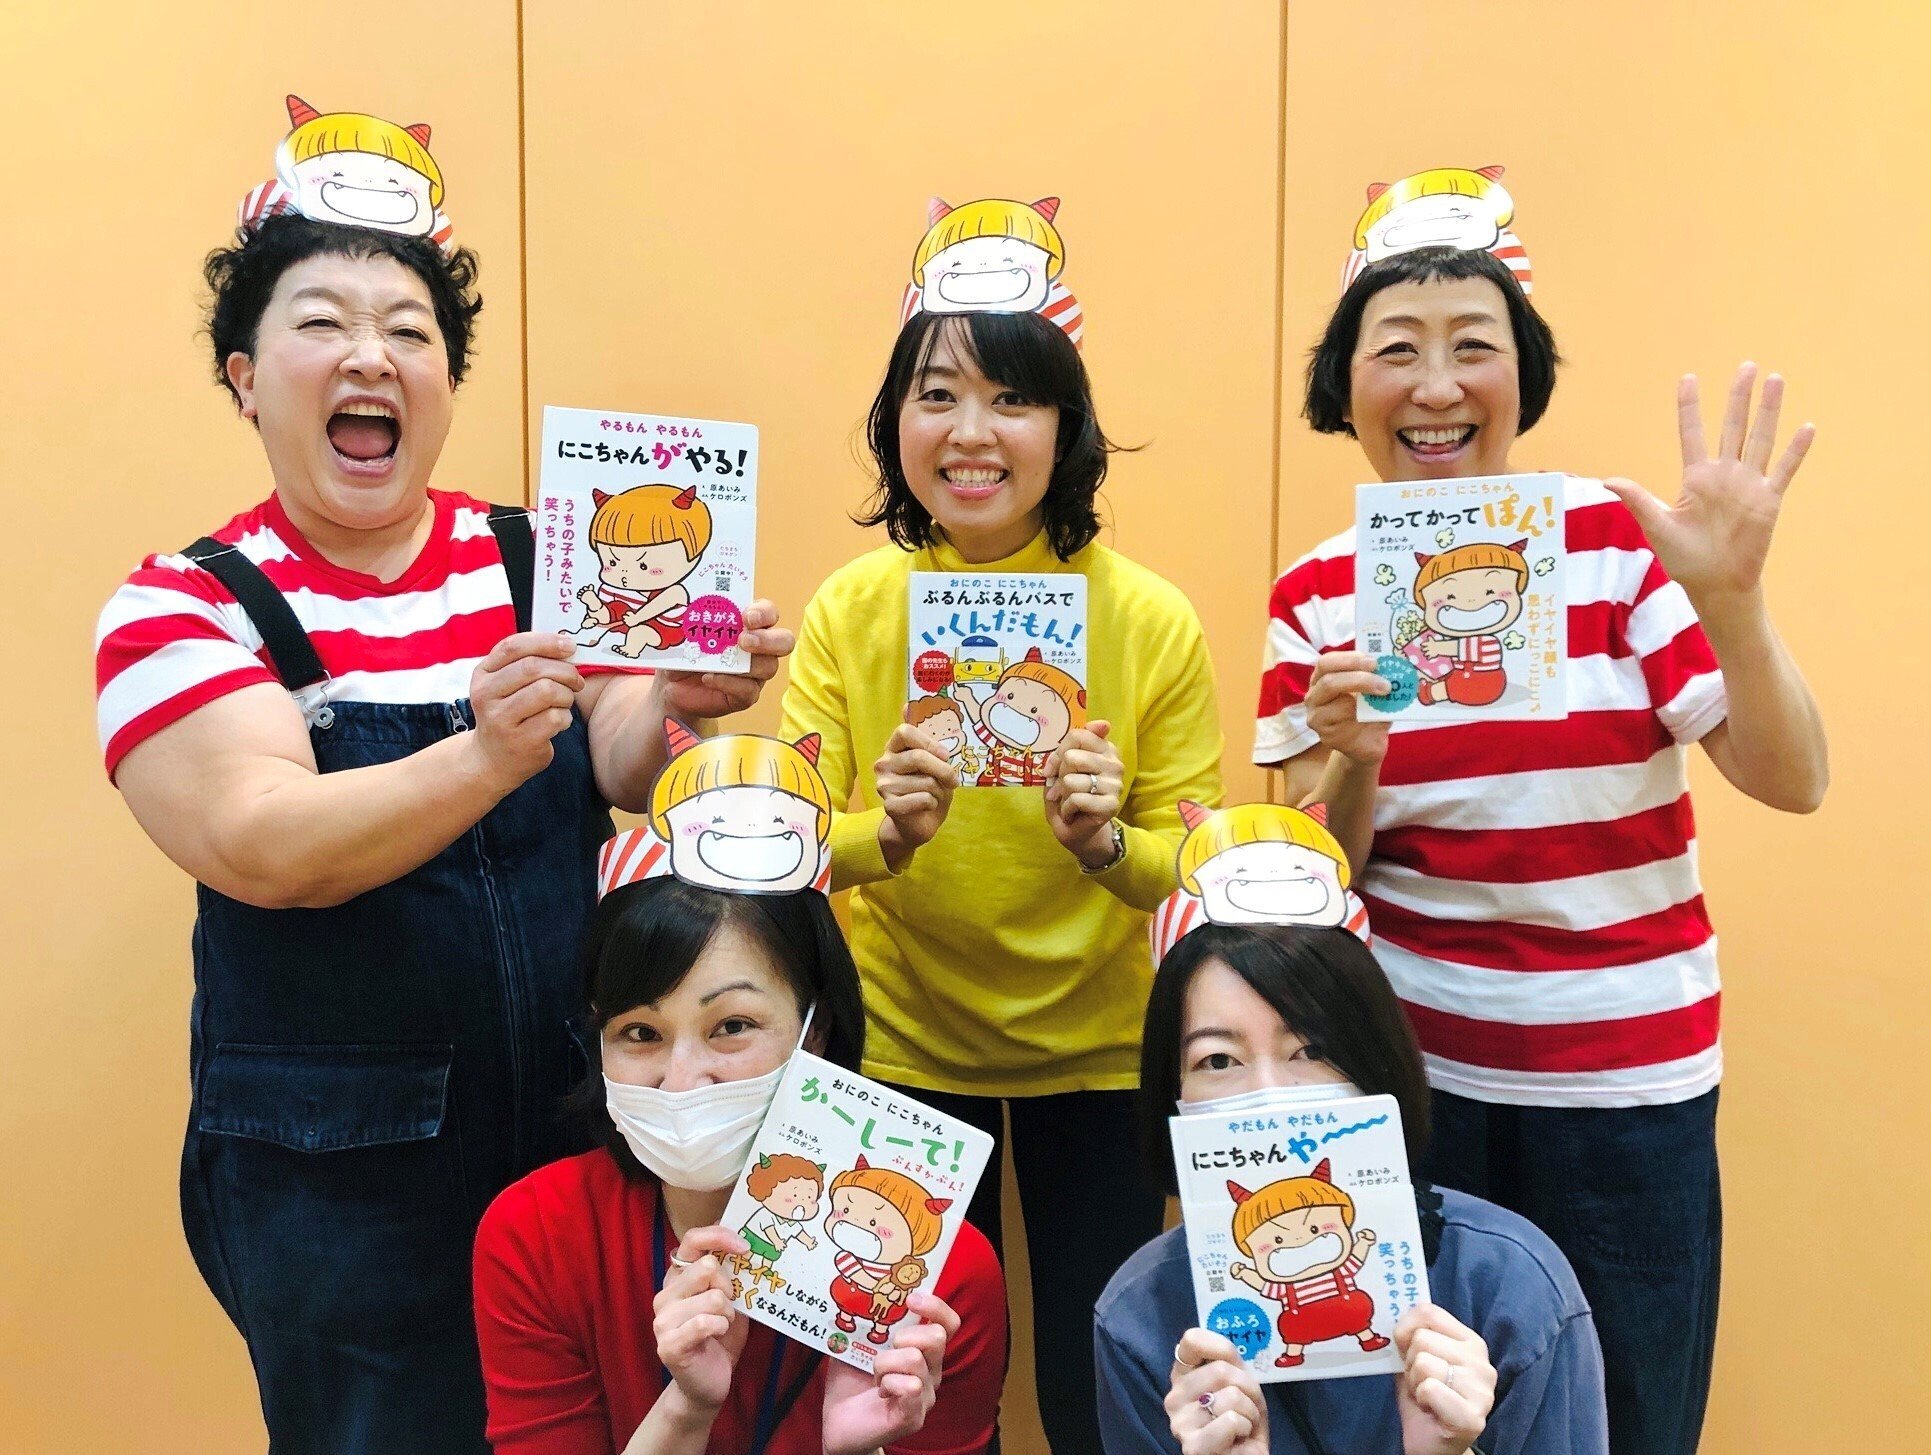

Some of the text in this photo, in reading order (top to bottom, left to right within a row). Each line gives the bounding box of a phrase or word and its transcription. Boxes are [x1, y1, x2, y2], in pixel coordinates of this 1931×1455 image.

[600, 419, 703, 439] やるもん やるもん
[558, 440, 748, 477] にこちゃんがやる!
[709, 483, 742, 494] 原あいみ
[1401, 483, 1514, 499] おにのこ にこちゃん
[544, 497, 559, 582] 笑っちゃう!
[559, 498, 575, 614] うちの子みたいで
[950, 578, 1047, 589] おにのこ にこちゃん
[923, 590, 1074, 607] ぶるんぶるんバスで
[688, 610, 738, 625] おきがえ
[687, 624, 738, 640] イヤイヤ
[921, 609, 1083, 648] いくんだもん!
[832, 1078, 944, 1136] おにのこ にこちゃん
[800, 1076, 966, 1173] かーしーて!
[1228, 1112, 1339, 1133] やだもん やだもん
[1215, 1314, 1260, 1330] おふろ
